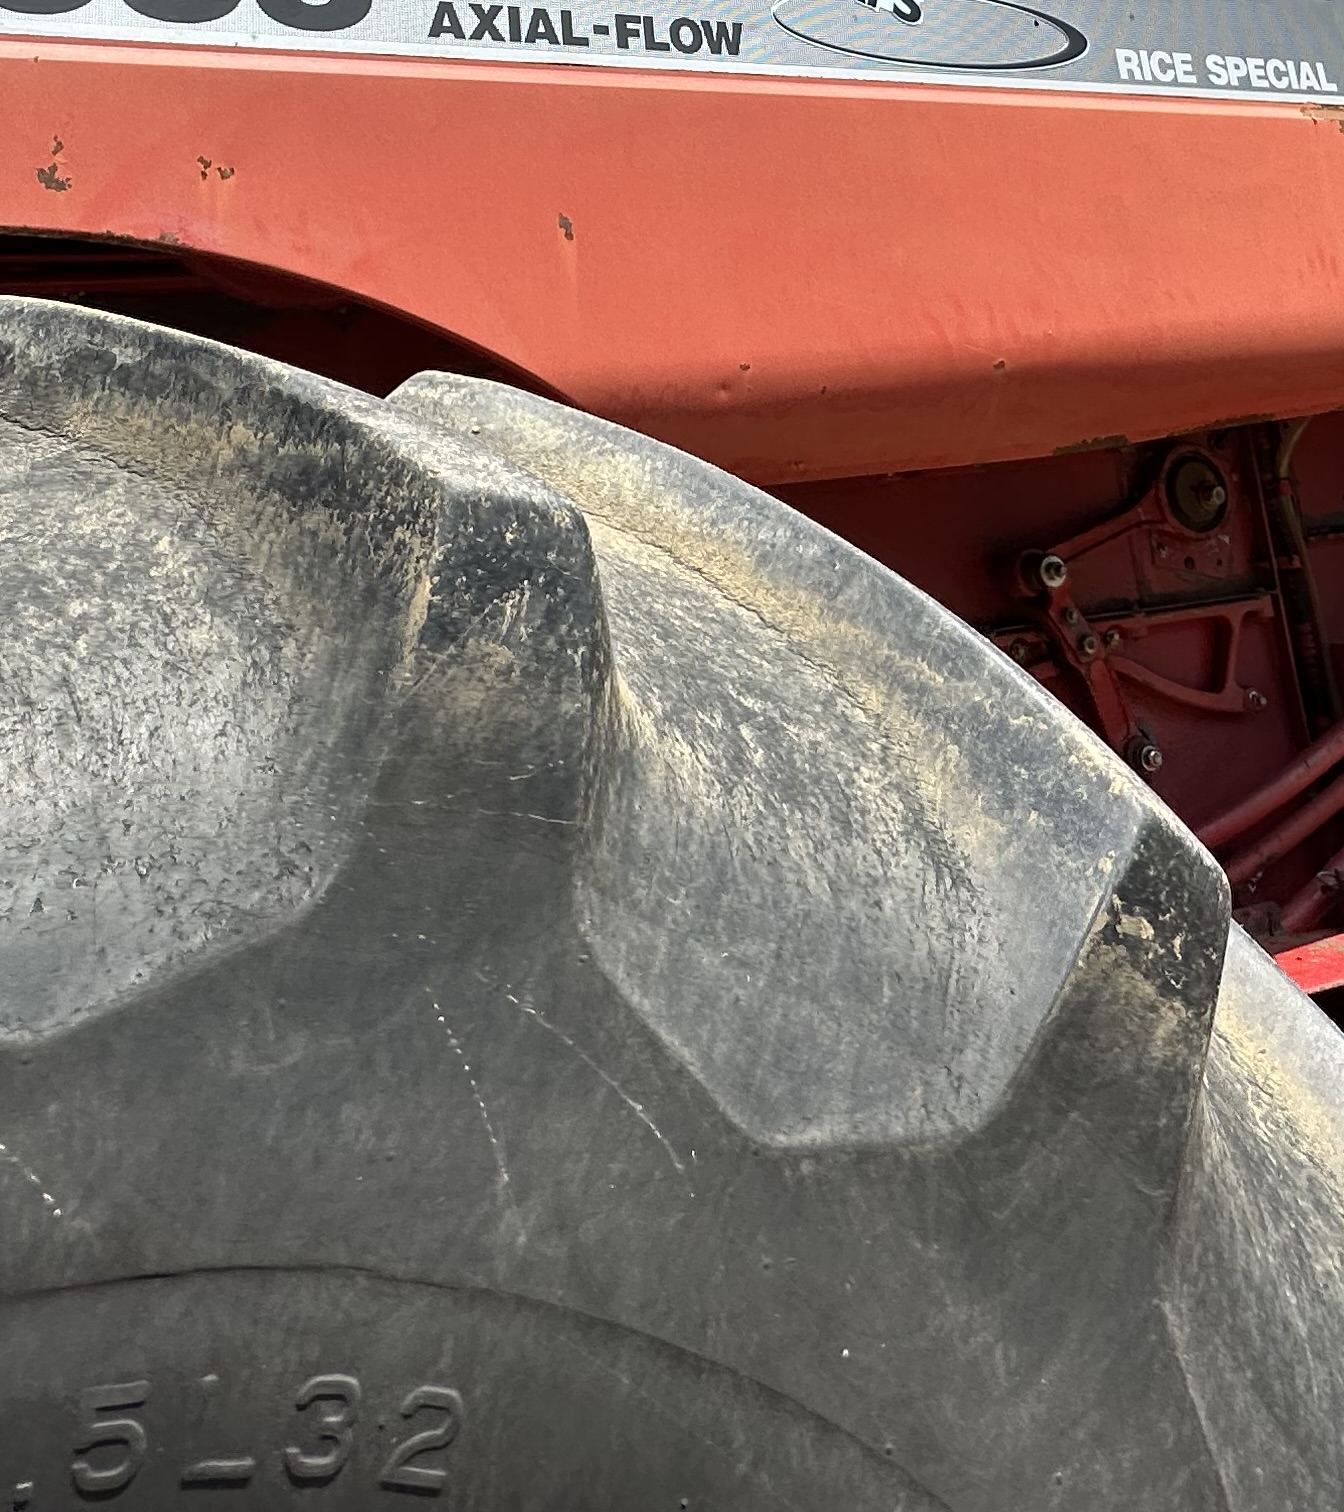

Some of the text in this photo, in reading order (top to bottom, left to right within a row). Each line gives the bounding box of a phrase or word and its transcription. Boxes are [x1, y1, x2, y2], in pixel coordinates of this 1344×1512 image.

[427, 0, 743, 56] AXIAL-FLOW
[1114, 48, 1338, 93] RICE SPECIAL
